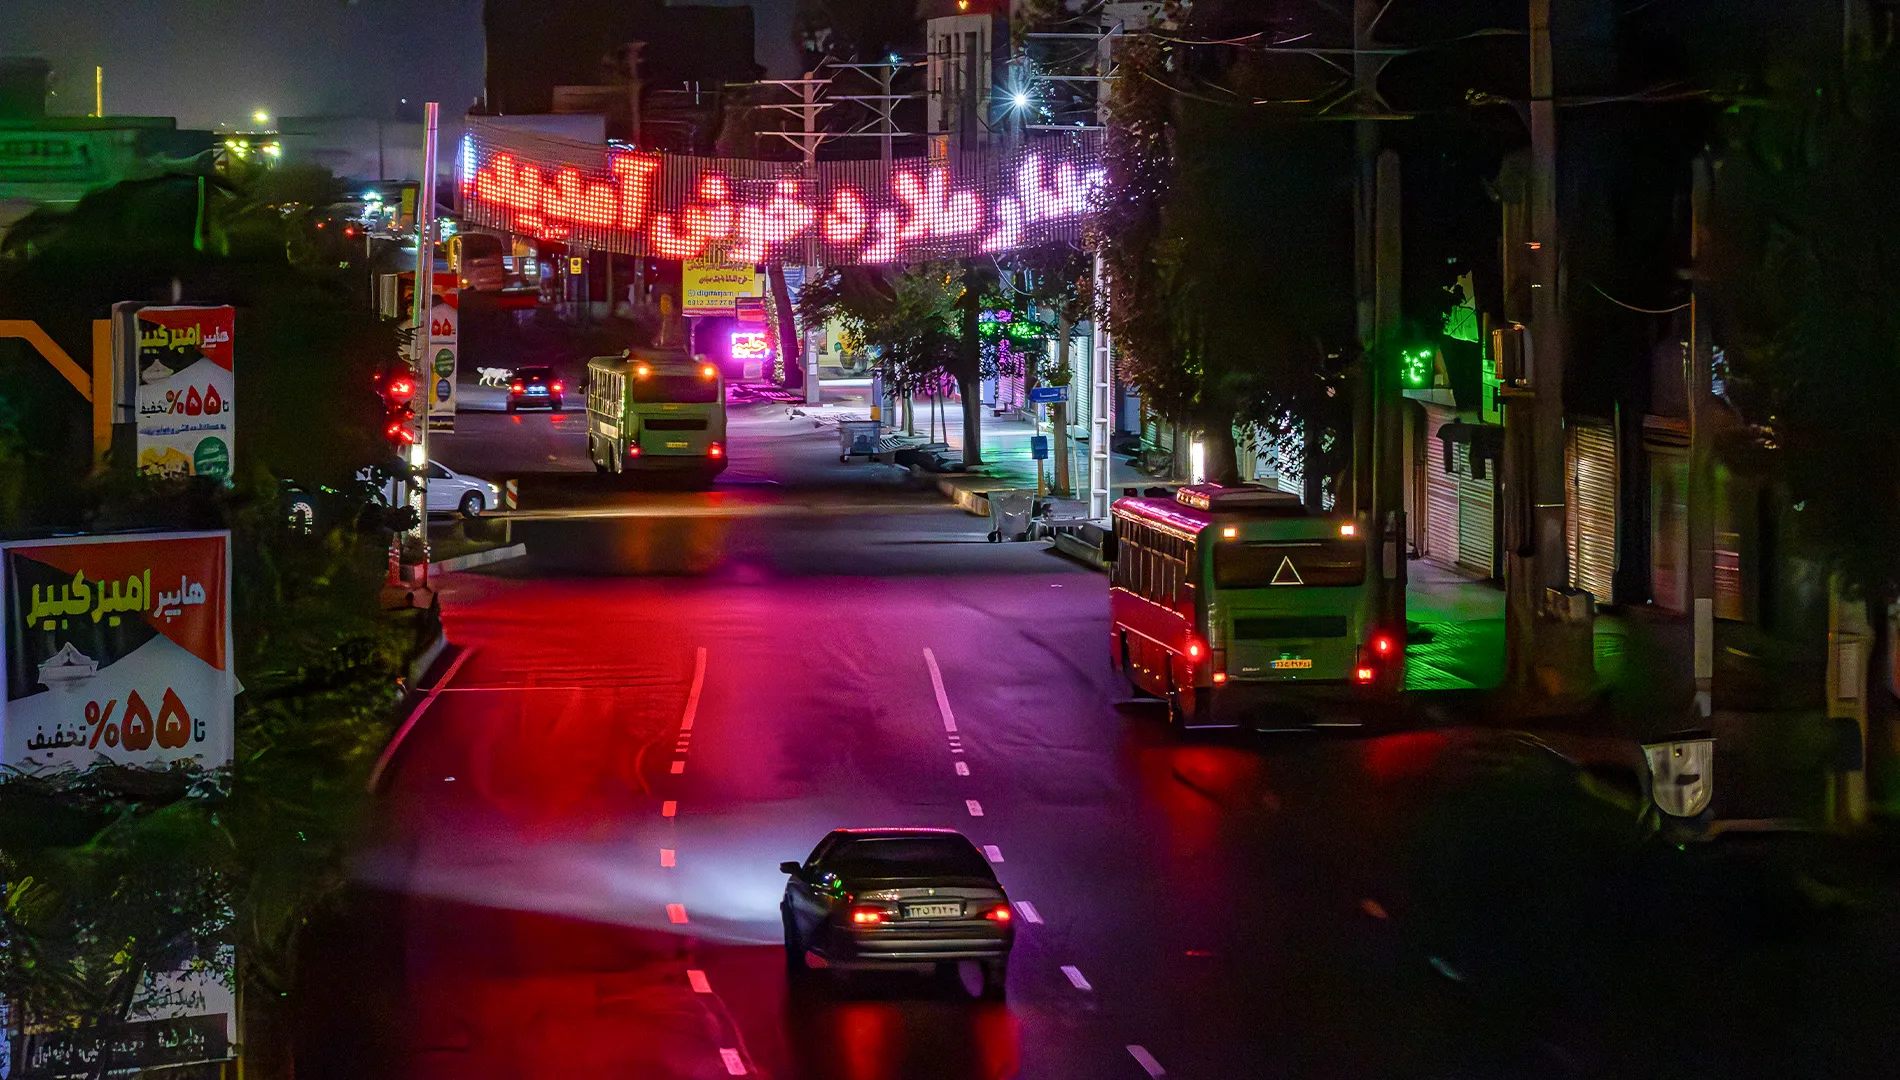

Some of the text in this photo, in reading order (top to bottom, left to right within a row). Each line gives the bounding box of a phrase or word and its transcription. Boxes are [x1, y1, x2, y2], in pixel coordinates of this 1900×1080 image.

[474, 151, 660, 241] آمدید
[651, 170, 817, 264] خوش
[820, 168, 983, 262] ملارد
[201, 326, 229, 349] هایپر
[222, 399, 230, 413] تا
[153, 575, 207, 624] هایپر
[27, 723, 87, 758] تخفیف
[193, 718, 206, 743] تا
